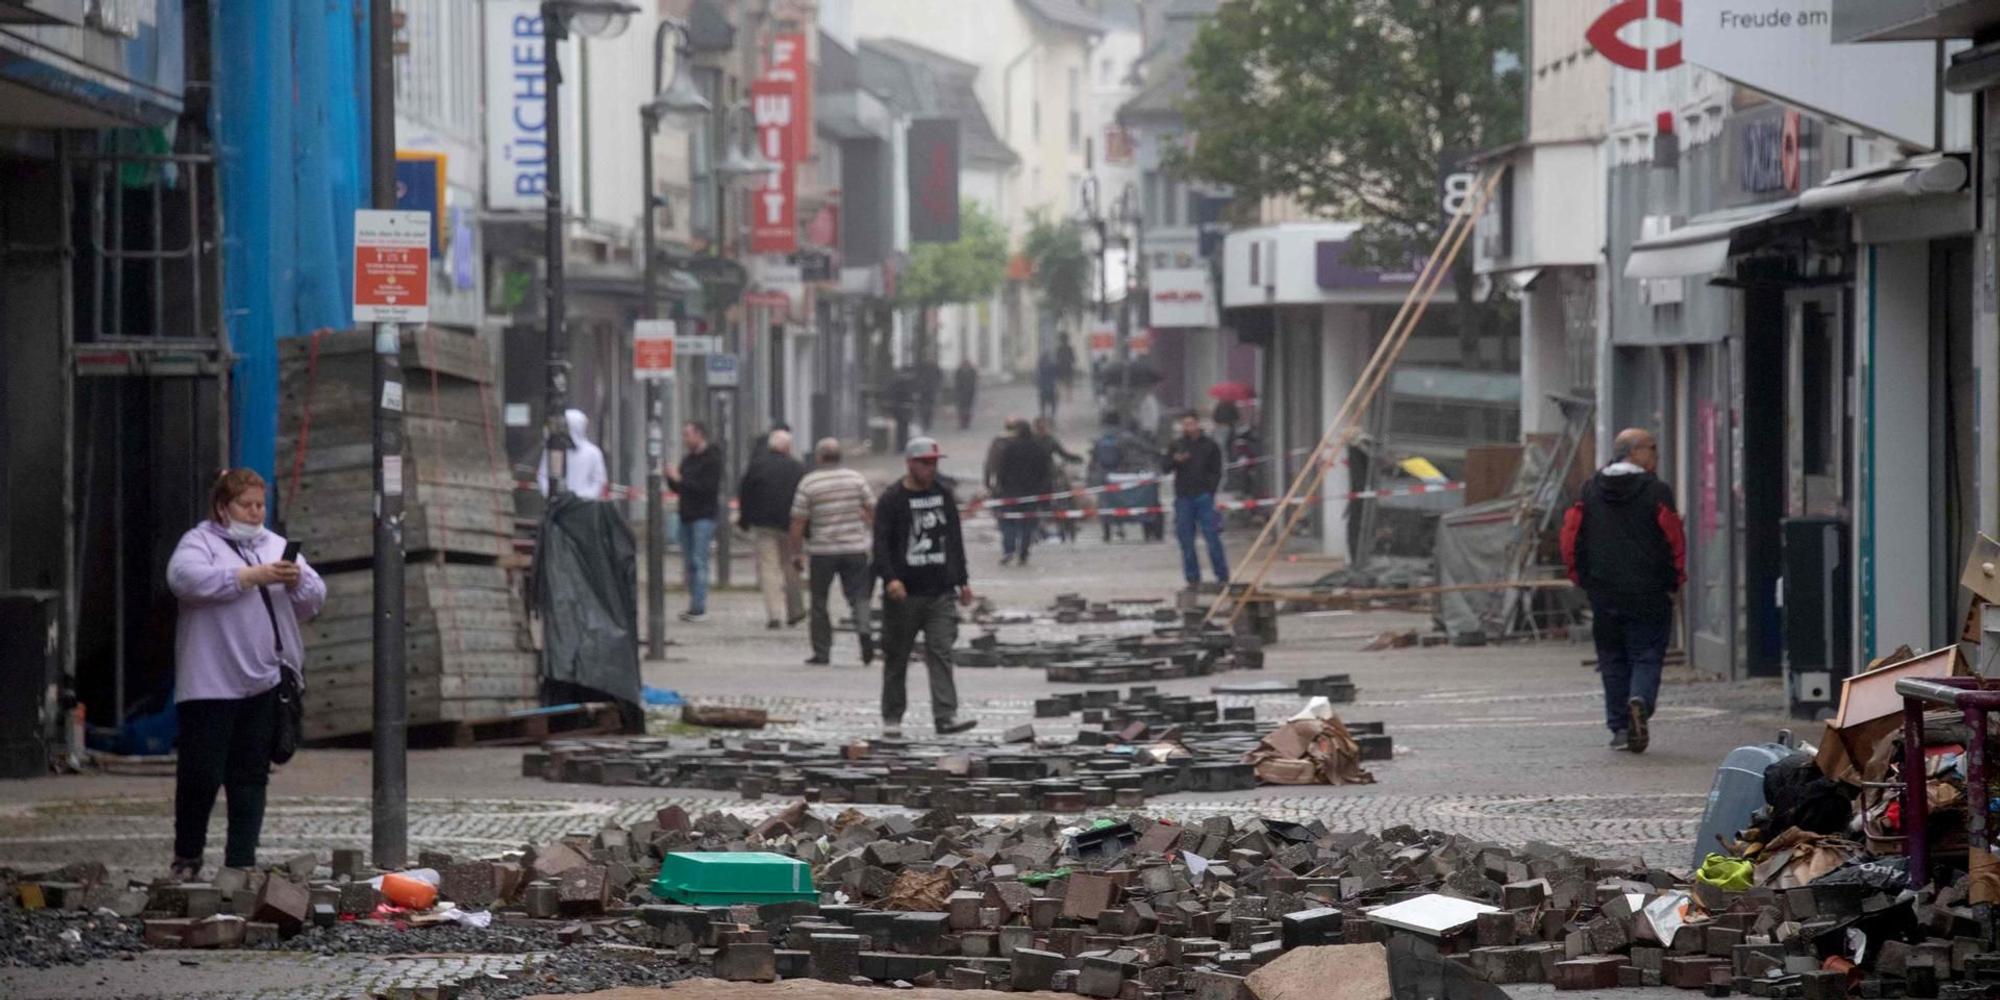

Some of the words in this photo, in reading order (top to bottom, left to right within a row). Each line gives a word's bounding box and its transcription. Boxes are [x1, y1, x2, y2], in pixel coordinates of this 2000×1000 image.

[1720, 8, 1792, 29] Freude
[1797, 10, 1828, 26] am
[503, 14, 546, 197] BÜCHER
[1859, 862, 1905, 879] Only
